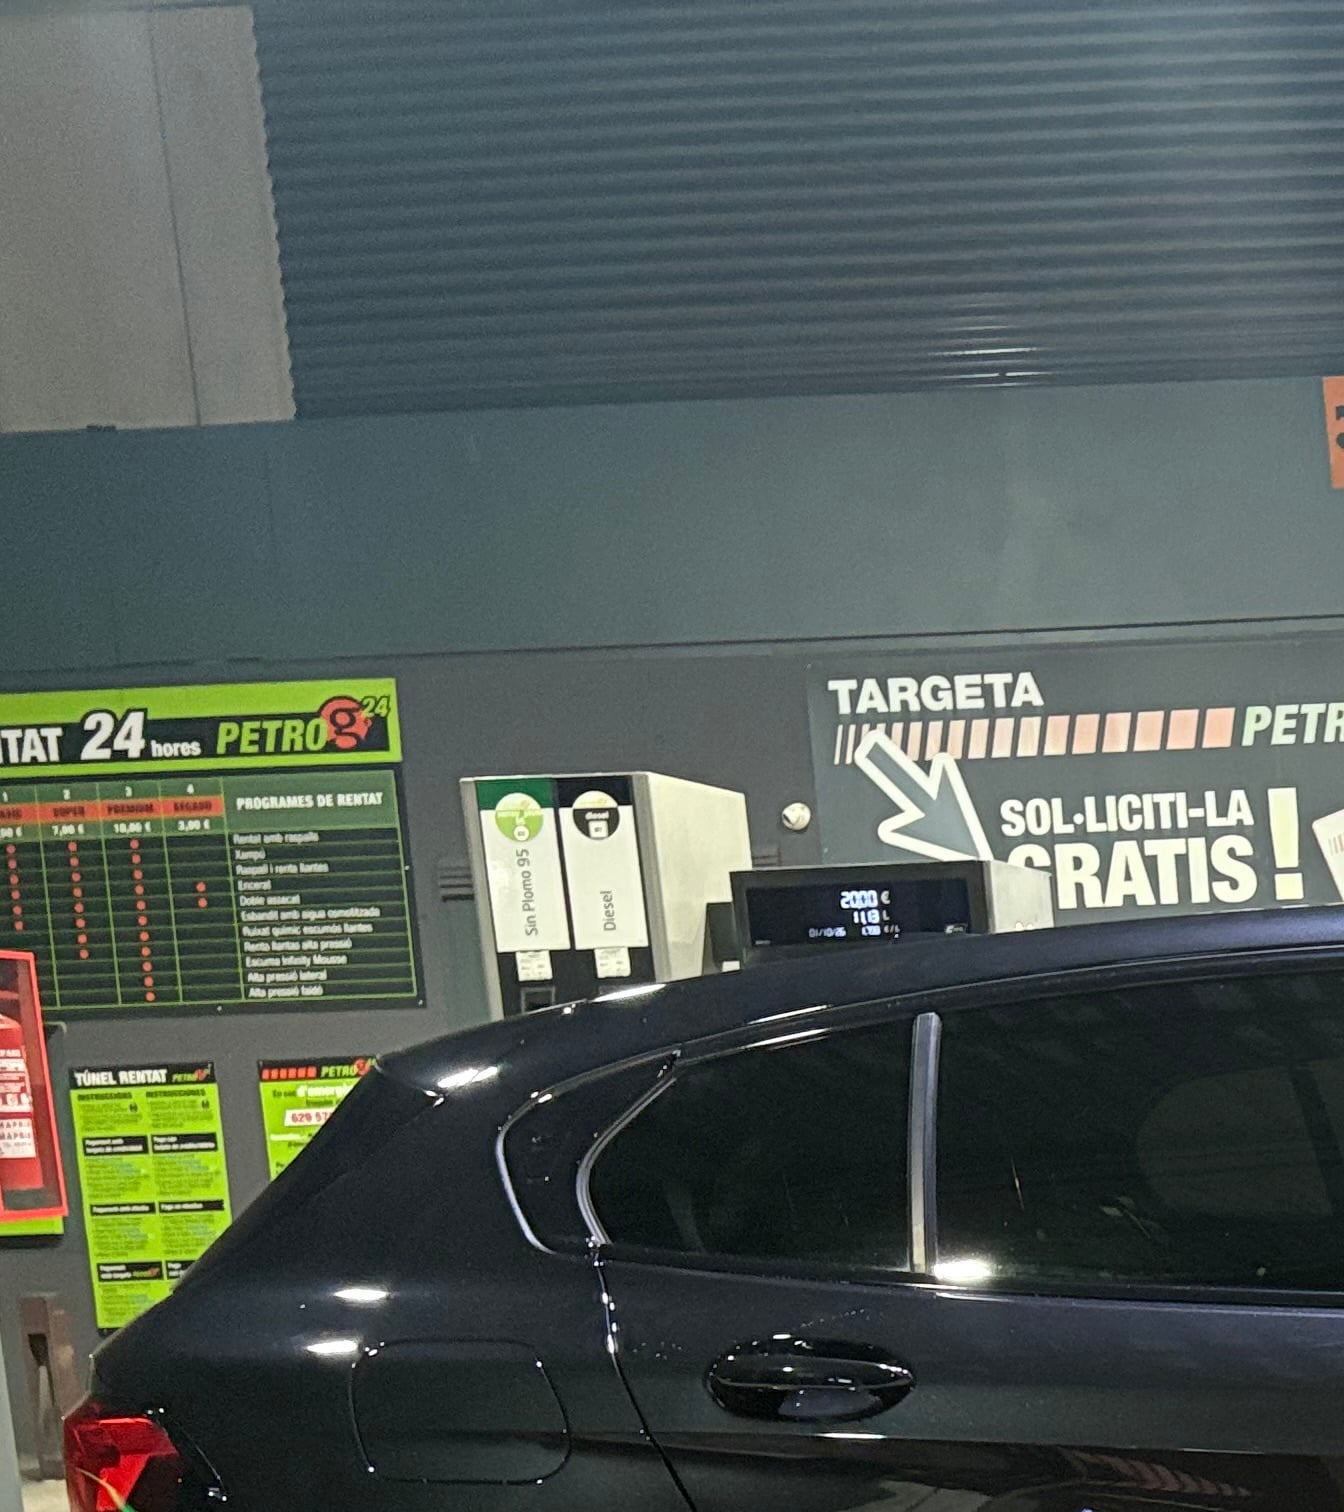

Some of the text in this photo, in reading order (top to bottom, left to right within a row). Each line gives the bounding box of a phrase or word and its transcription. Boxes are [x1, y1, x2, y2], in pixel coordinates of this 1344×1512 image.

[828, 671, 1044, 715] TARGETA
[0, 728, 63, 763] TAT
[80, 711, 148, 761] 24
[151, 739, 201, 758] hores
[236, 792, 384, 811] PROGRAMES DE RENTAT
[515, 848, 530, 868] 95
[521, 871, 536, 914] Plomo
[603, 890, 617, 931] Diesel
[525, 917, 538, 936] Sin
[74, 1069, 116, 1086] TÚNEL
[118, 1068, 168, 1084] RENTAT
